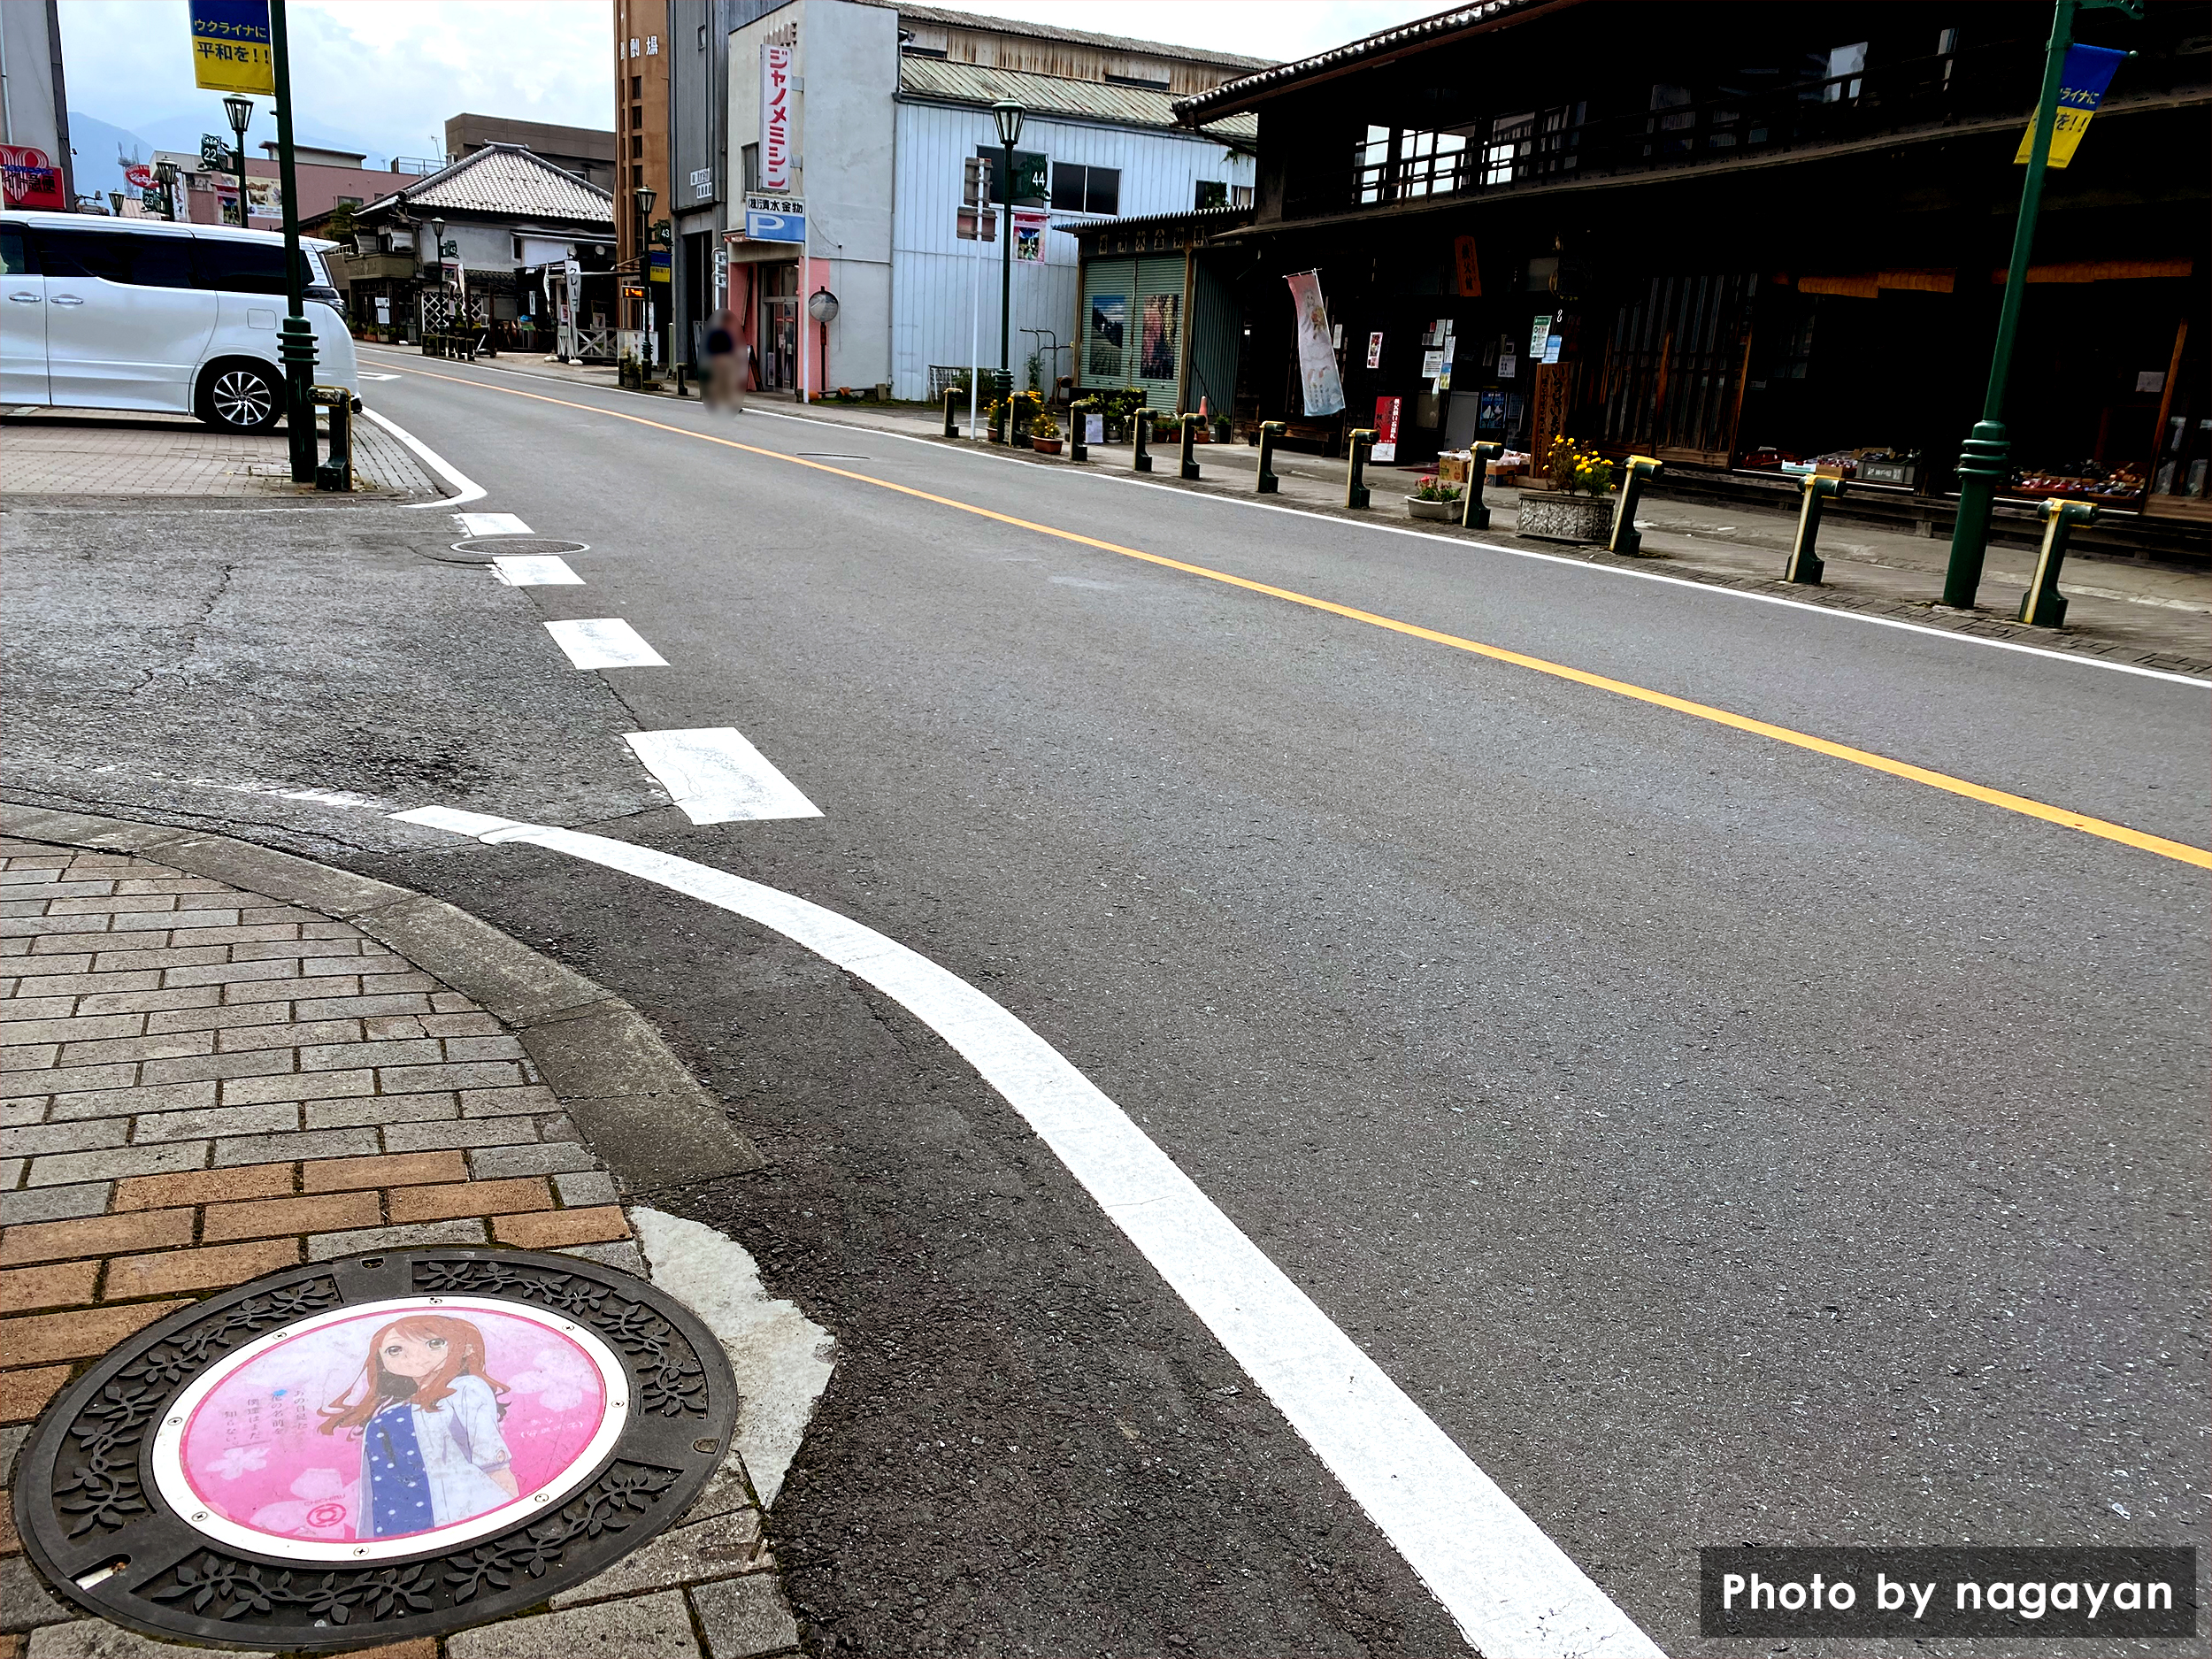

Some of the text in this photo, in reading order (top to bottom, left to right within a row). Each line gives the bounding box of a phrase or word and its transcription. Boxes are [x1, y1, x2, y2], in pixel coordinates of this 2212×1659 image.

[195, 19, 267, 38] ウクライナに
[196, 41, 269, 65] 平和を！！
[2060, 87, 2100, 104] ライナに
[768, 48, 787, 188] ジャノメミシン
[204, 147, 218, 163] 22
[1032, 171, 1046, 187] 44
[144, 196, 155, 206] 23
[749, 212, 785, 236] P
[661, 228, 670, 238] 43
